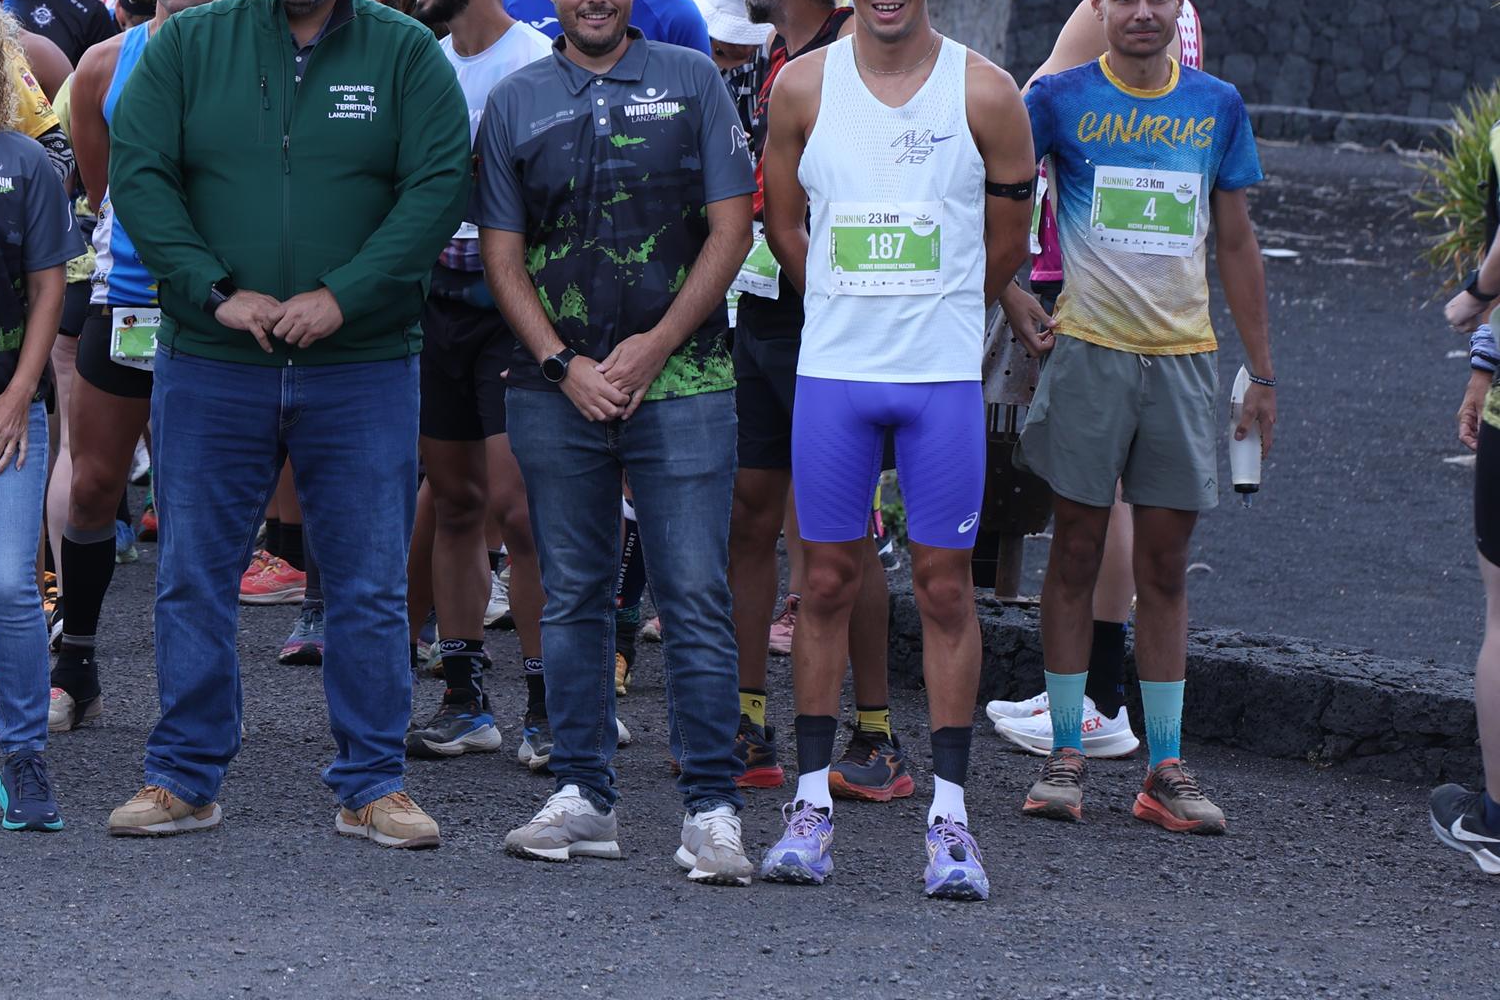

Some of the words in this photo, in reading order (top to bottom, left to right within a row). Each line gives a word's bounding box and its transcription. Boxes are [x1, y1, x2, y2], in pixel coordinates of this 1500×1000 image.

[329, 85, 375, 93] GUARDIANES
[328, 112, 366, 120] LANZAROTE
[631, 113, 675, 123] LANZAROTE
[1077, 108, 1216, 150] CANARIAS
[1102, 176, 1134, 187] RUNNING
[1136, 178, 1148, 188] 23
[1150, 179, 1165, 189] Km
[1143, 197, 1157, 221] 4
[835, 214, 866, 223] RUNNING
[868, 213, 882, 224] 23
[884, 213, 900, 224] Km
[867, 232, 906, 260] 187
[1081, 716, 1103, 733] REX
